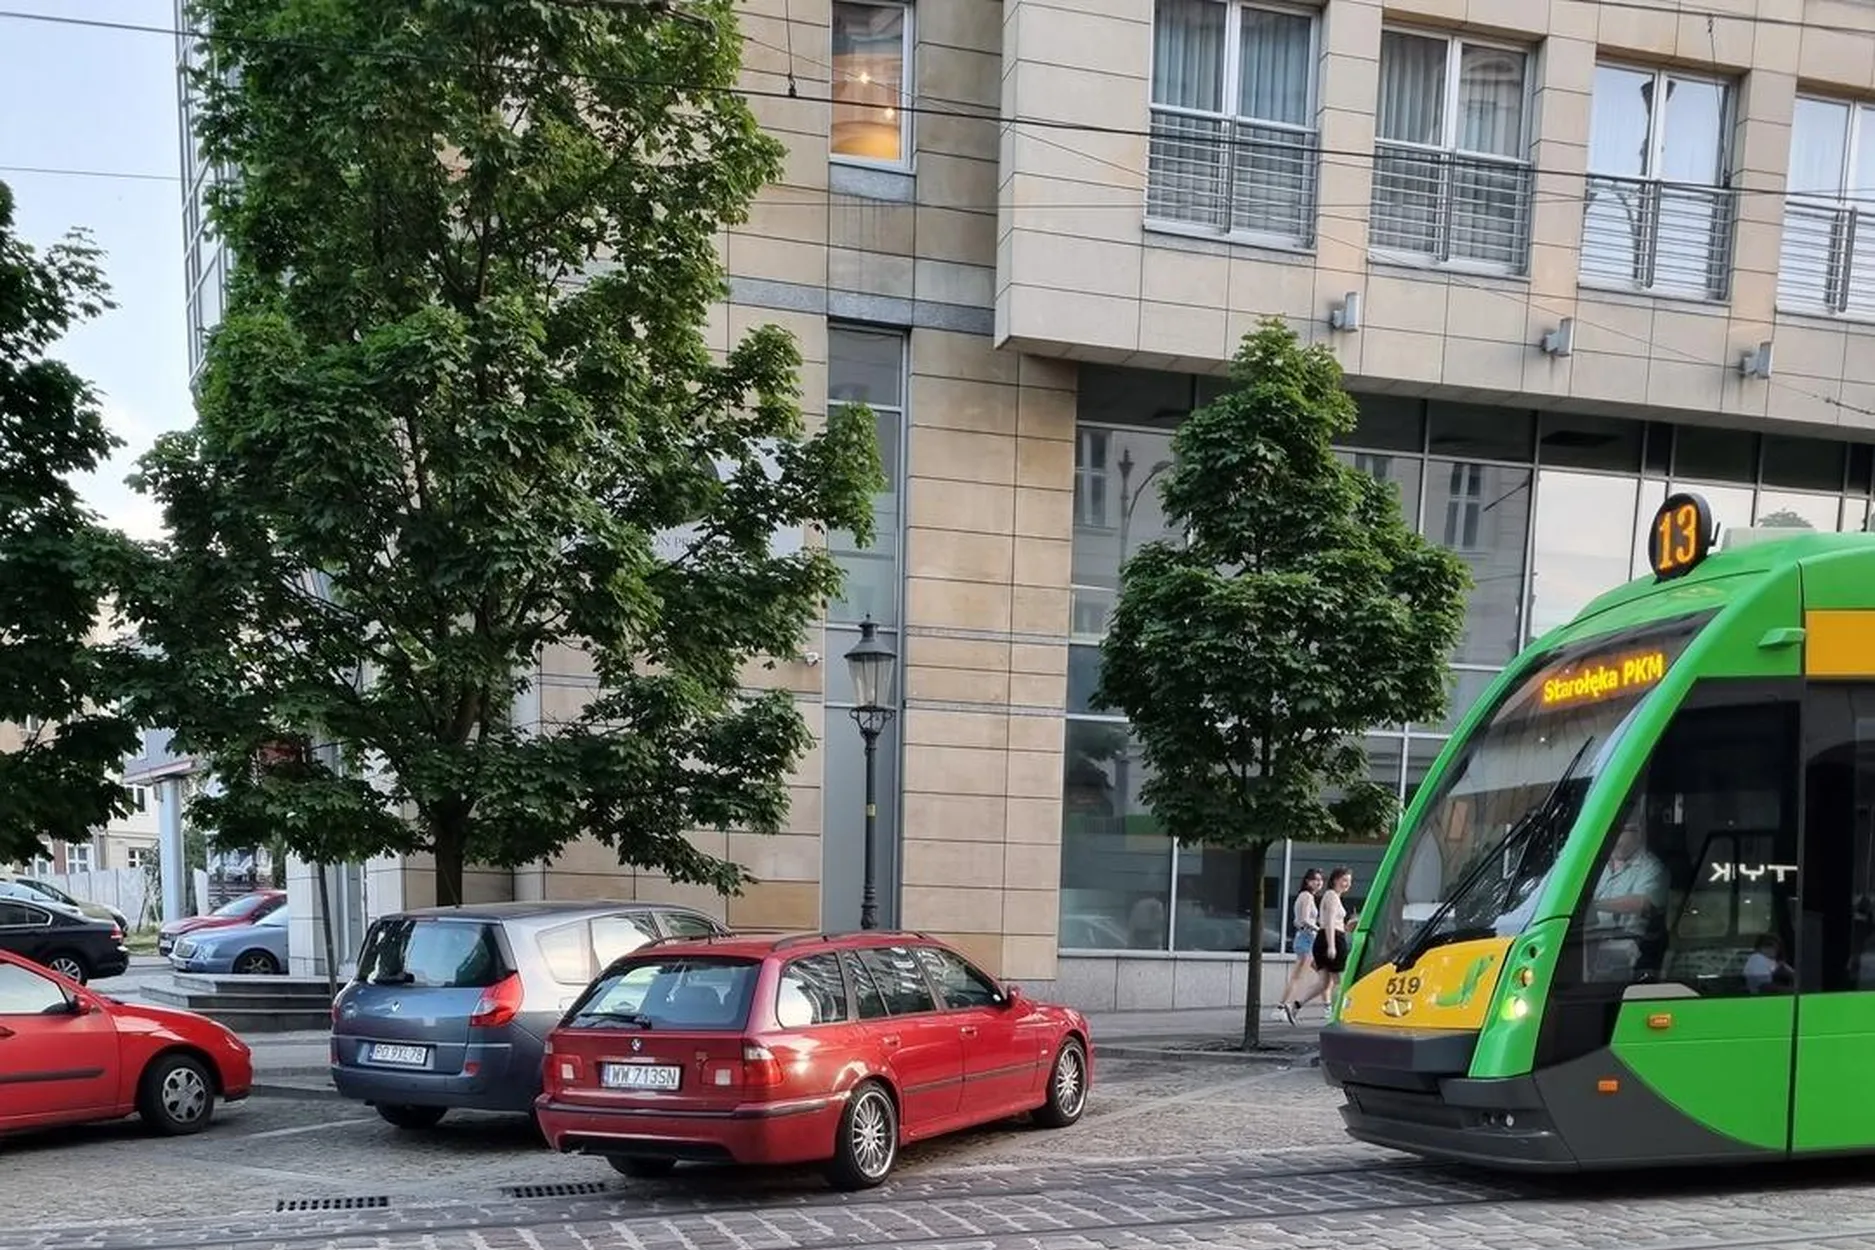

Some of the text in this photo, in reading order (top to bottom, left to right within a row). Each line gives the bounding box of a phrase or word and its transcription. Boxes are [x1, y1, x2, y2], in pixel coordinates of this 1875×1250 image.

[1659, 504, 1697, 570] 13
[1543, 652, 1664, 702] Starołęka PKM
[1386, 976, 1420, 995] 519
[612, 1067, 677, 1084] WW 713SN
